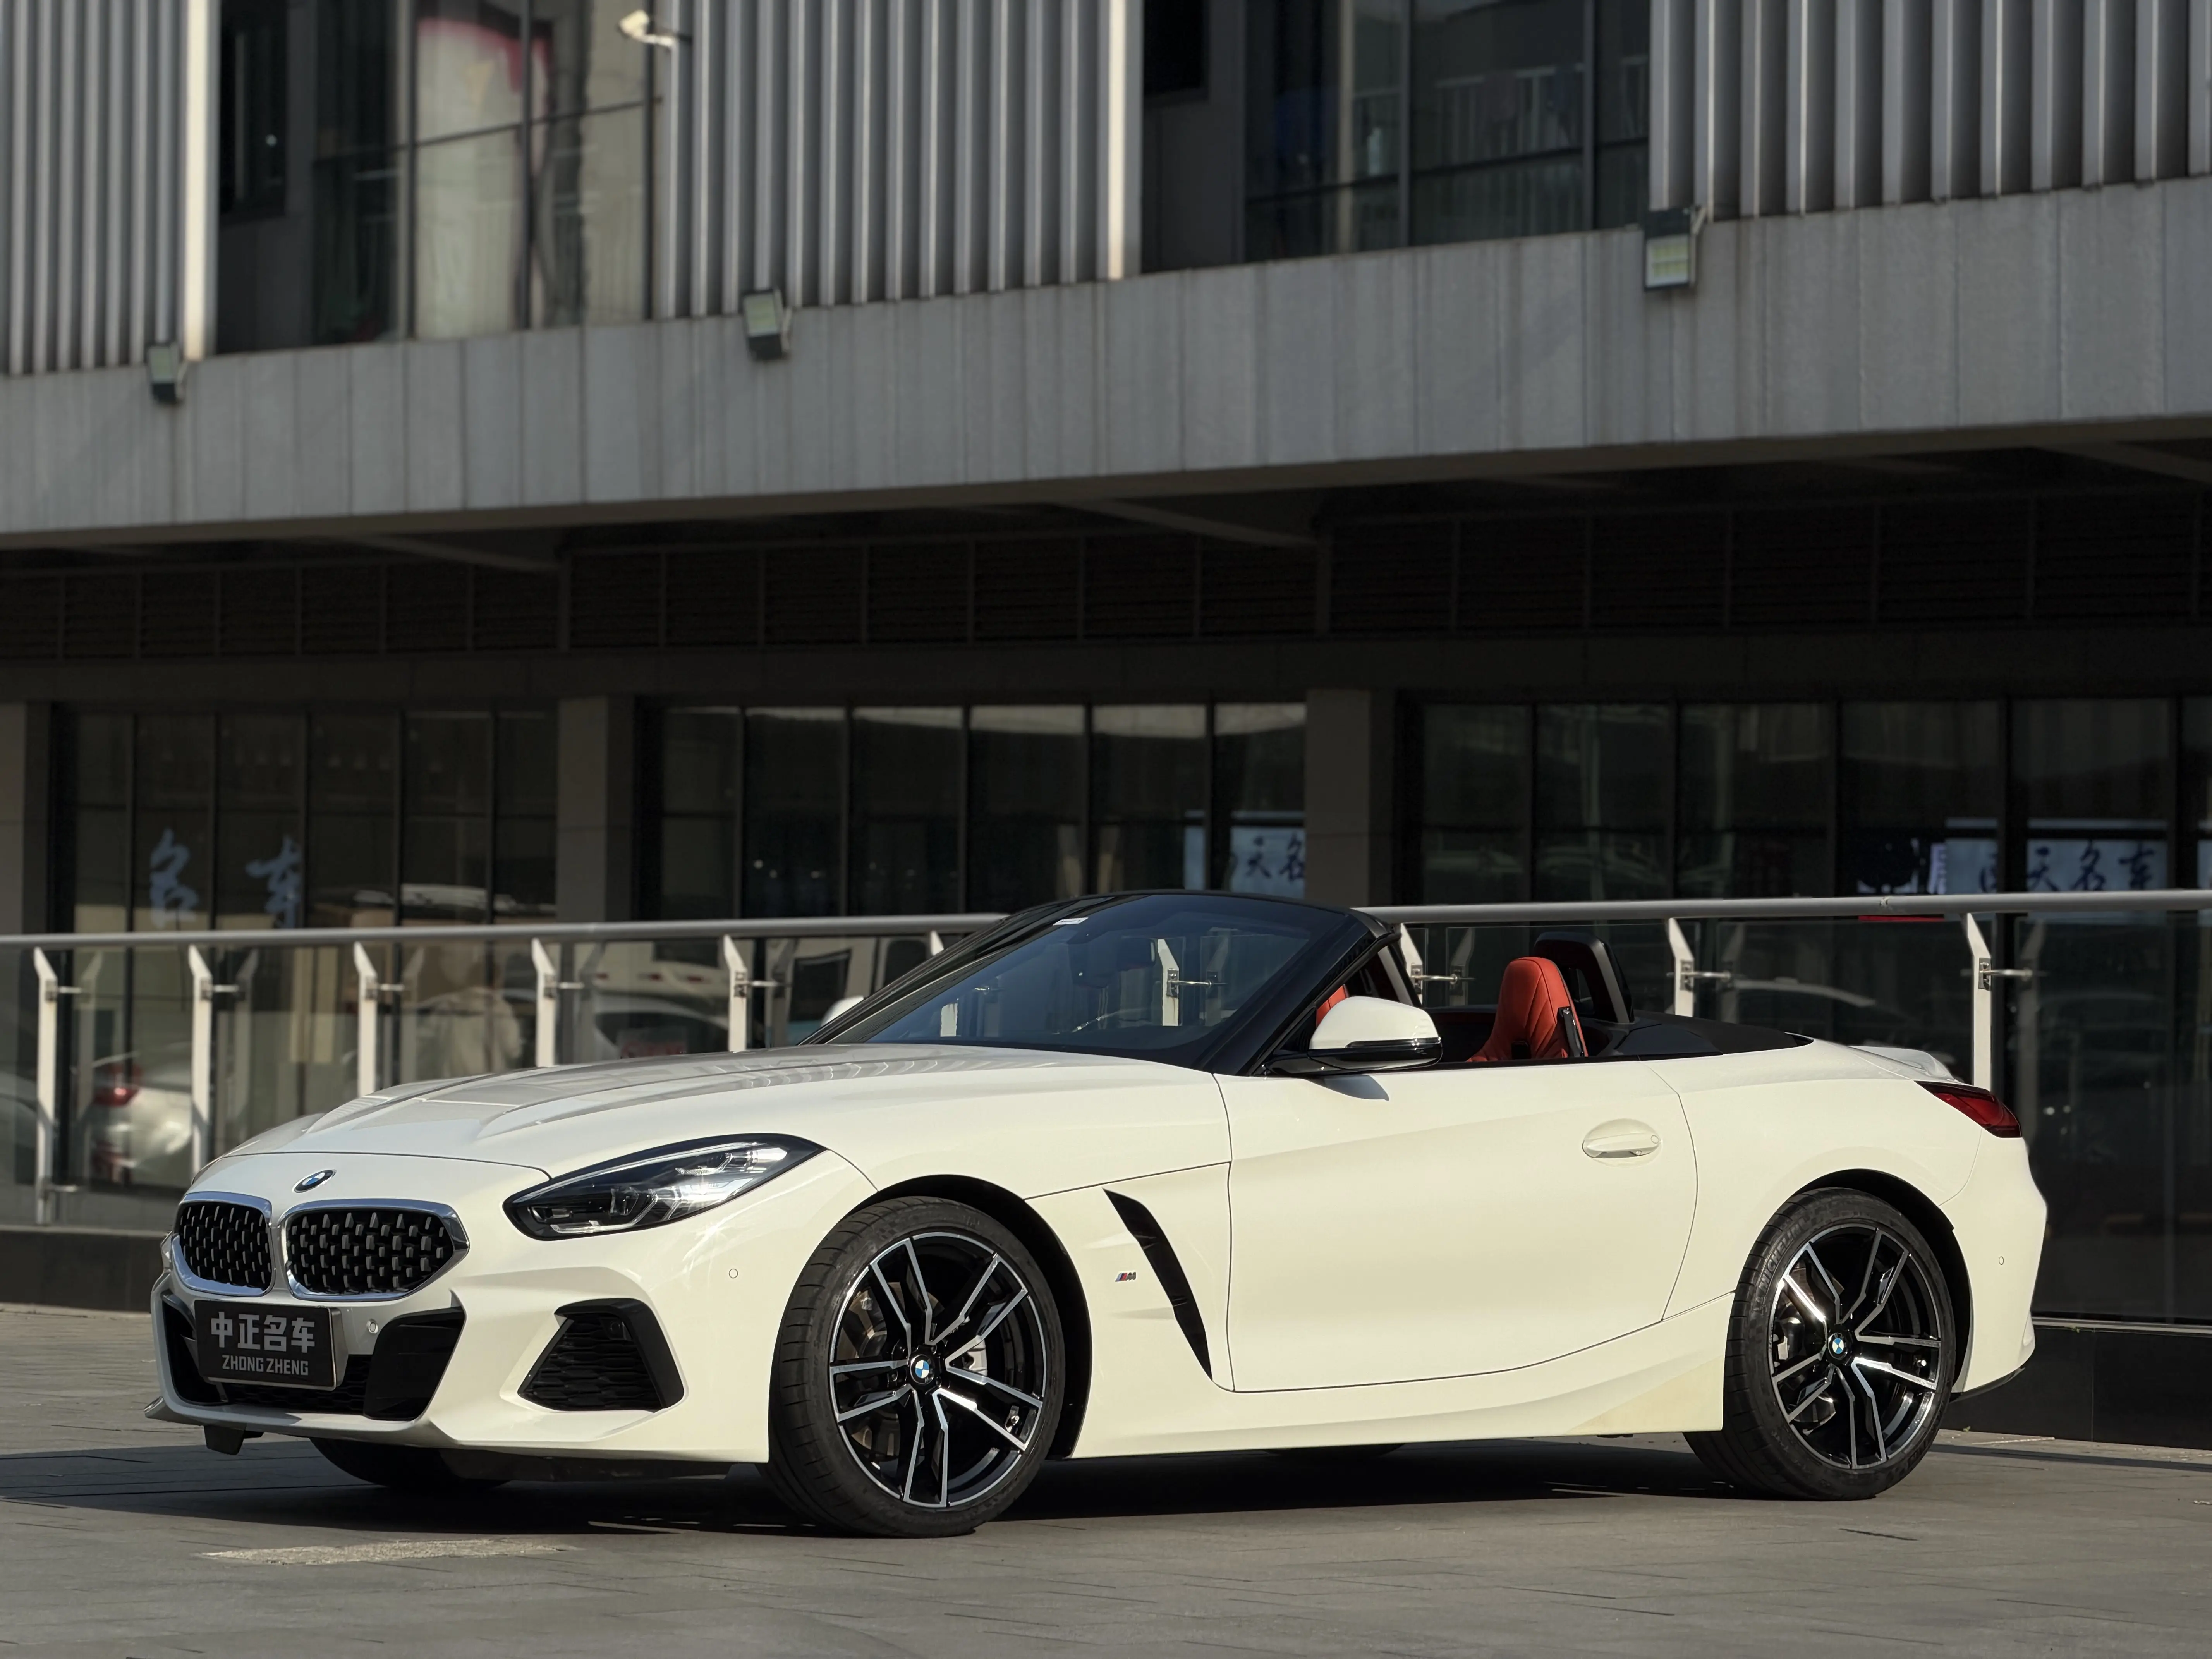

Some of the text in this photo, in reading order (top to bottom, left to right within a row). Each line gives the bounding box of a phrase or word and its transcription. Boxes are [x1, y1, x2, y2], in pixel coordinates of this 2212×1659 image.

[1759, 1223, 1802, 1293] MICHELIN
[211, 1311, 315, 1353] 中正名车
[222, 1355, 309, 1376] ZHONG ZHENG
